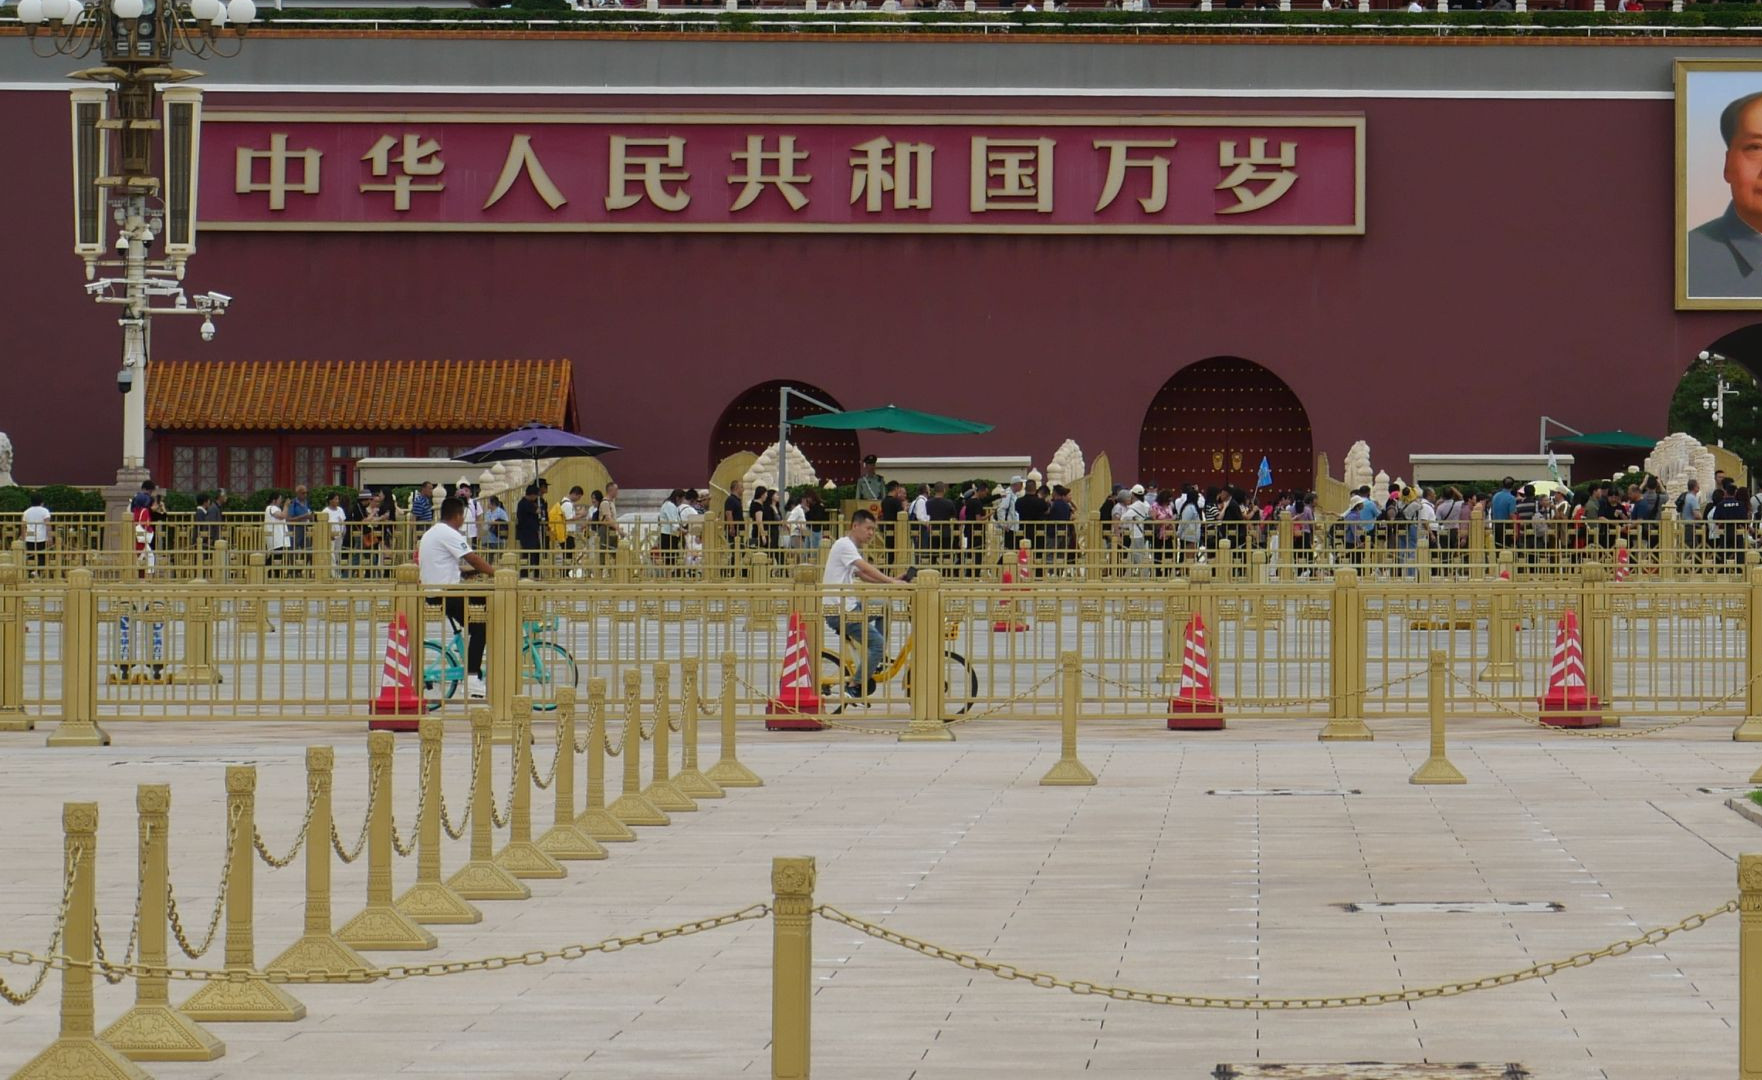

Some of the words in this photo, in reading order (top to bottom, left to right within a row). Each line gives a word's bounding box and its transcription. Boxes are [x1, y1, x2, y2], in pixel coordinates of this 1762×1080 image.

[235, 132, 1300, 215] 中华人民共和国万岁
